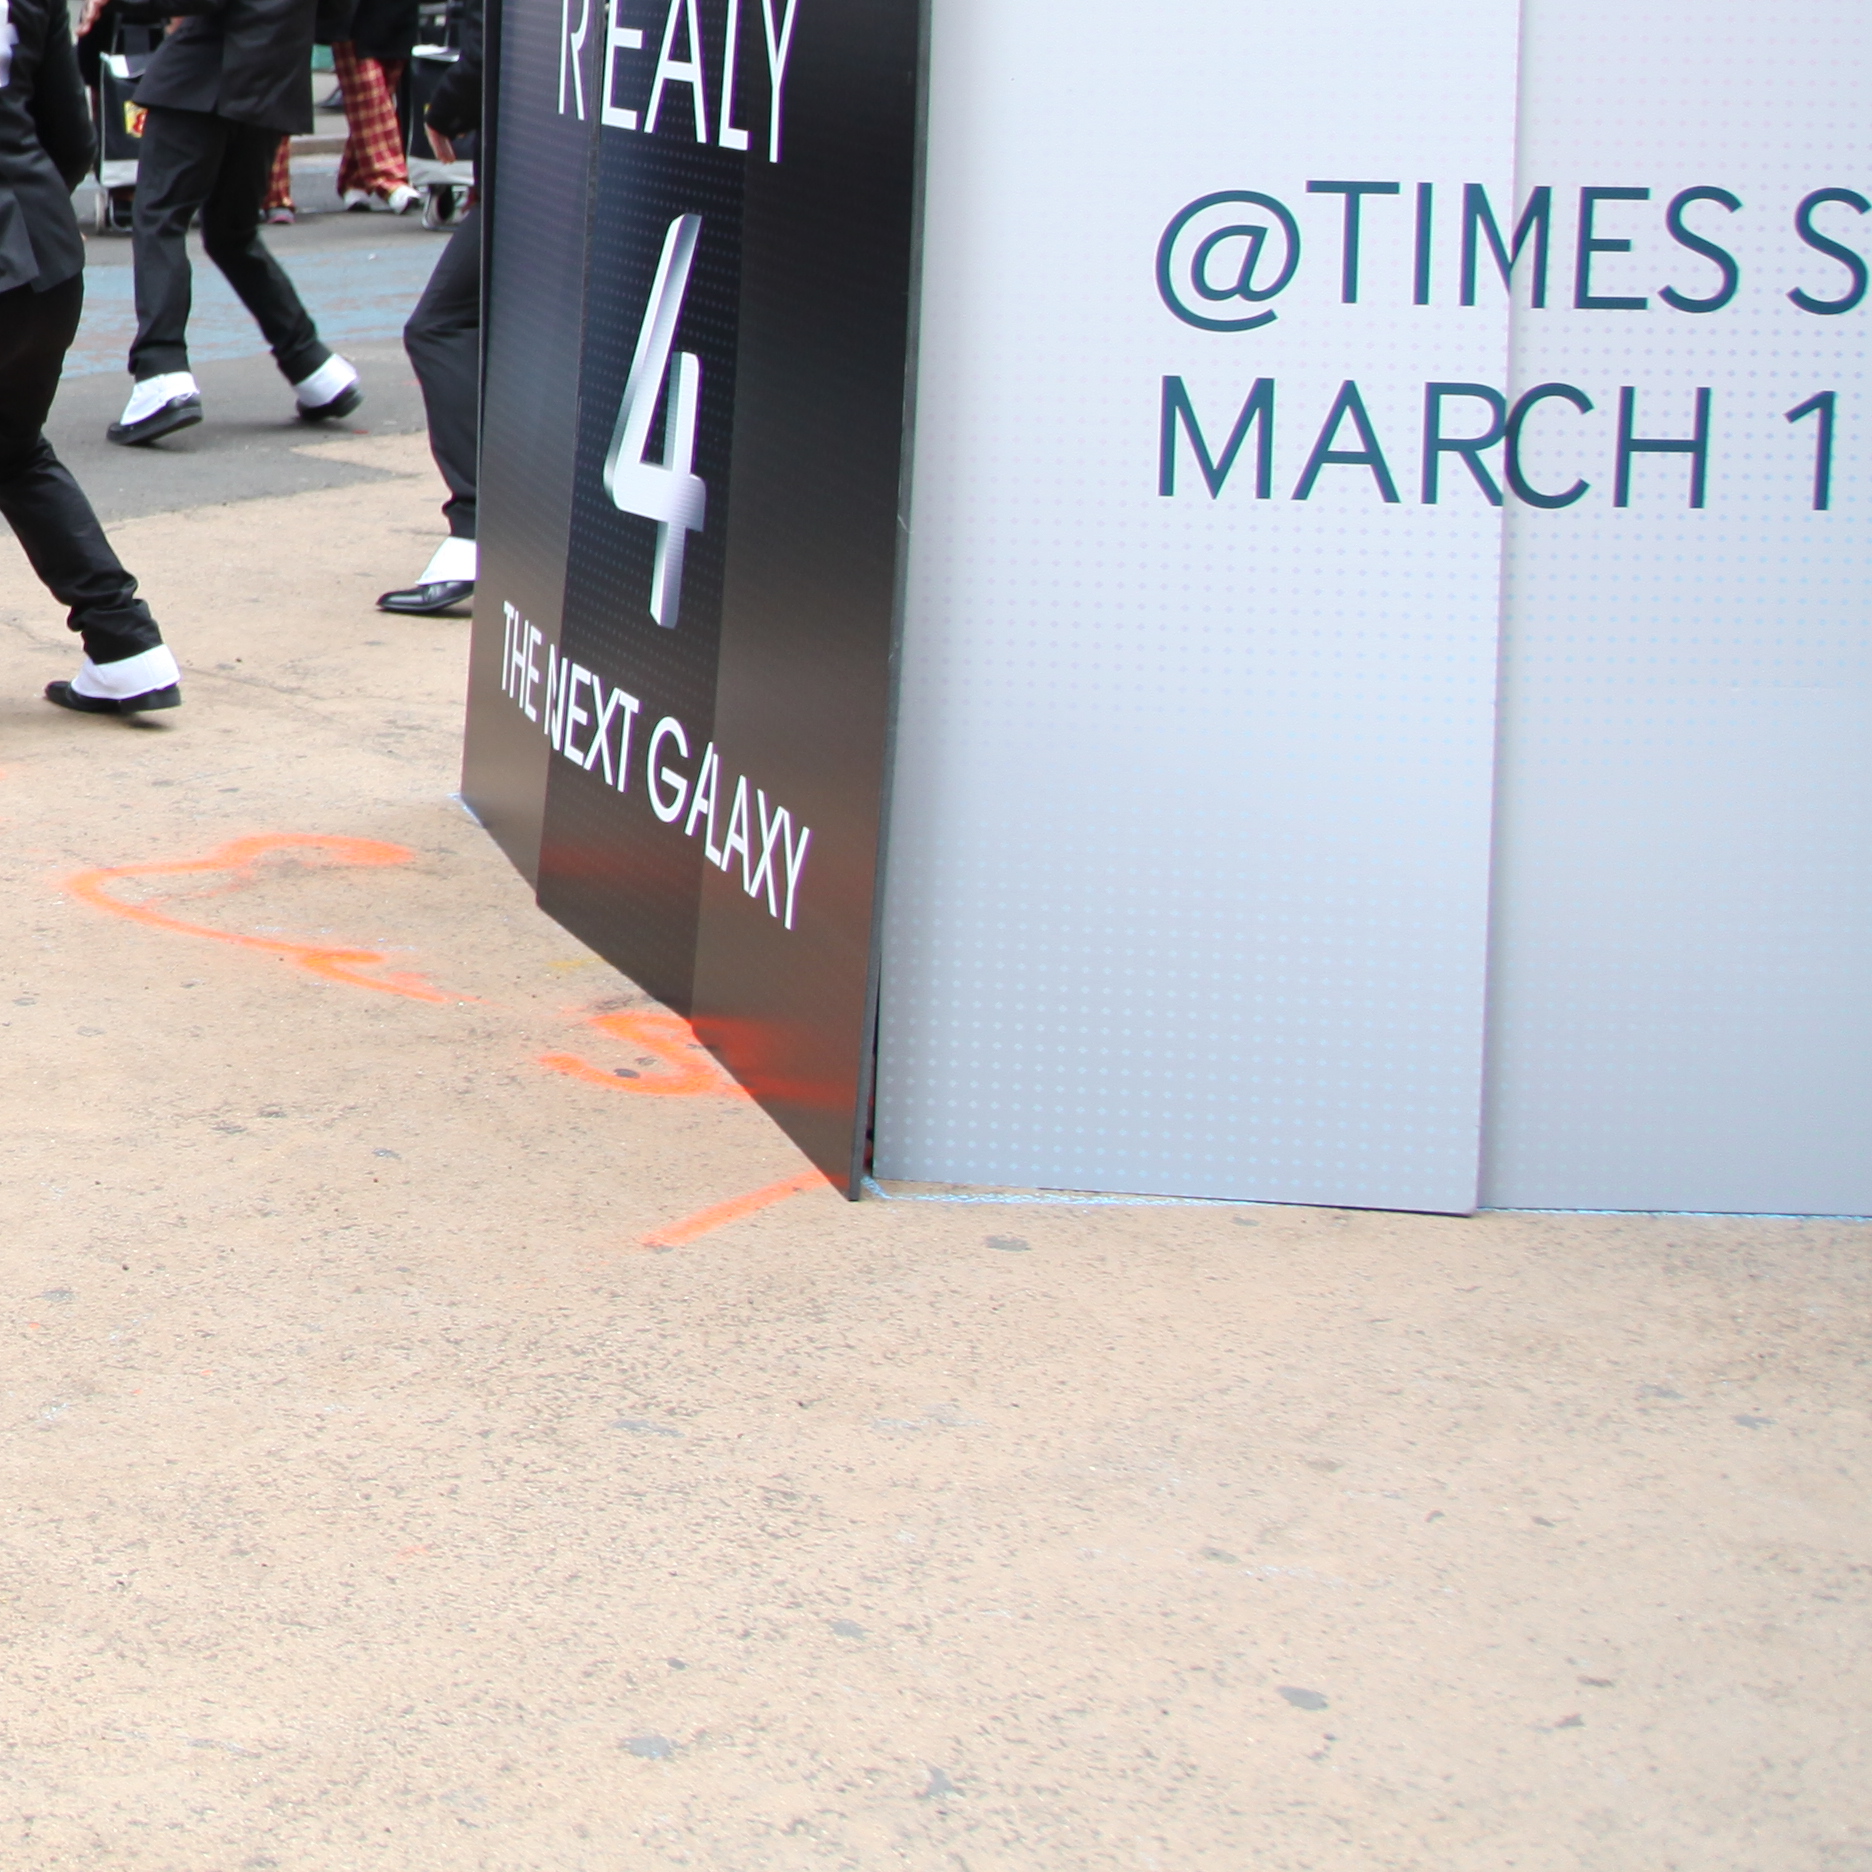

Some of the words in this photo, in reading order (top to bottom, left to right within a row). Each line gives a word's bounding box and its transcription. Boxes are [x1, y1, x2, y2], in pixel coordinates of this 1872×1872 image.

[1154, 179, 1744, 334] @TIMES
[603, 213, 708, 629] 4
[1157, 374, 1713, 510] MARCH
[501, 599, 543, 724] THE
[543, 643, 640, 794] NEXT
[645, 715, 812, 931] GALAXY
